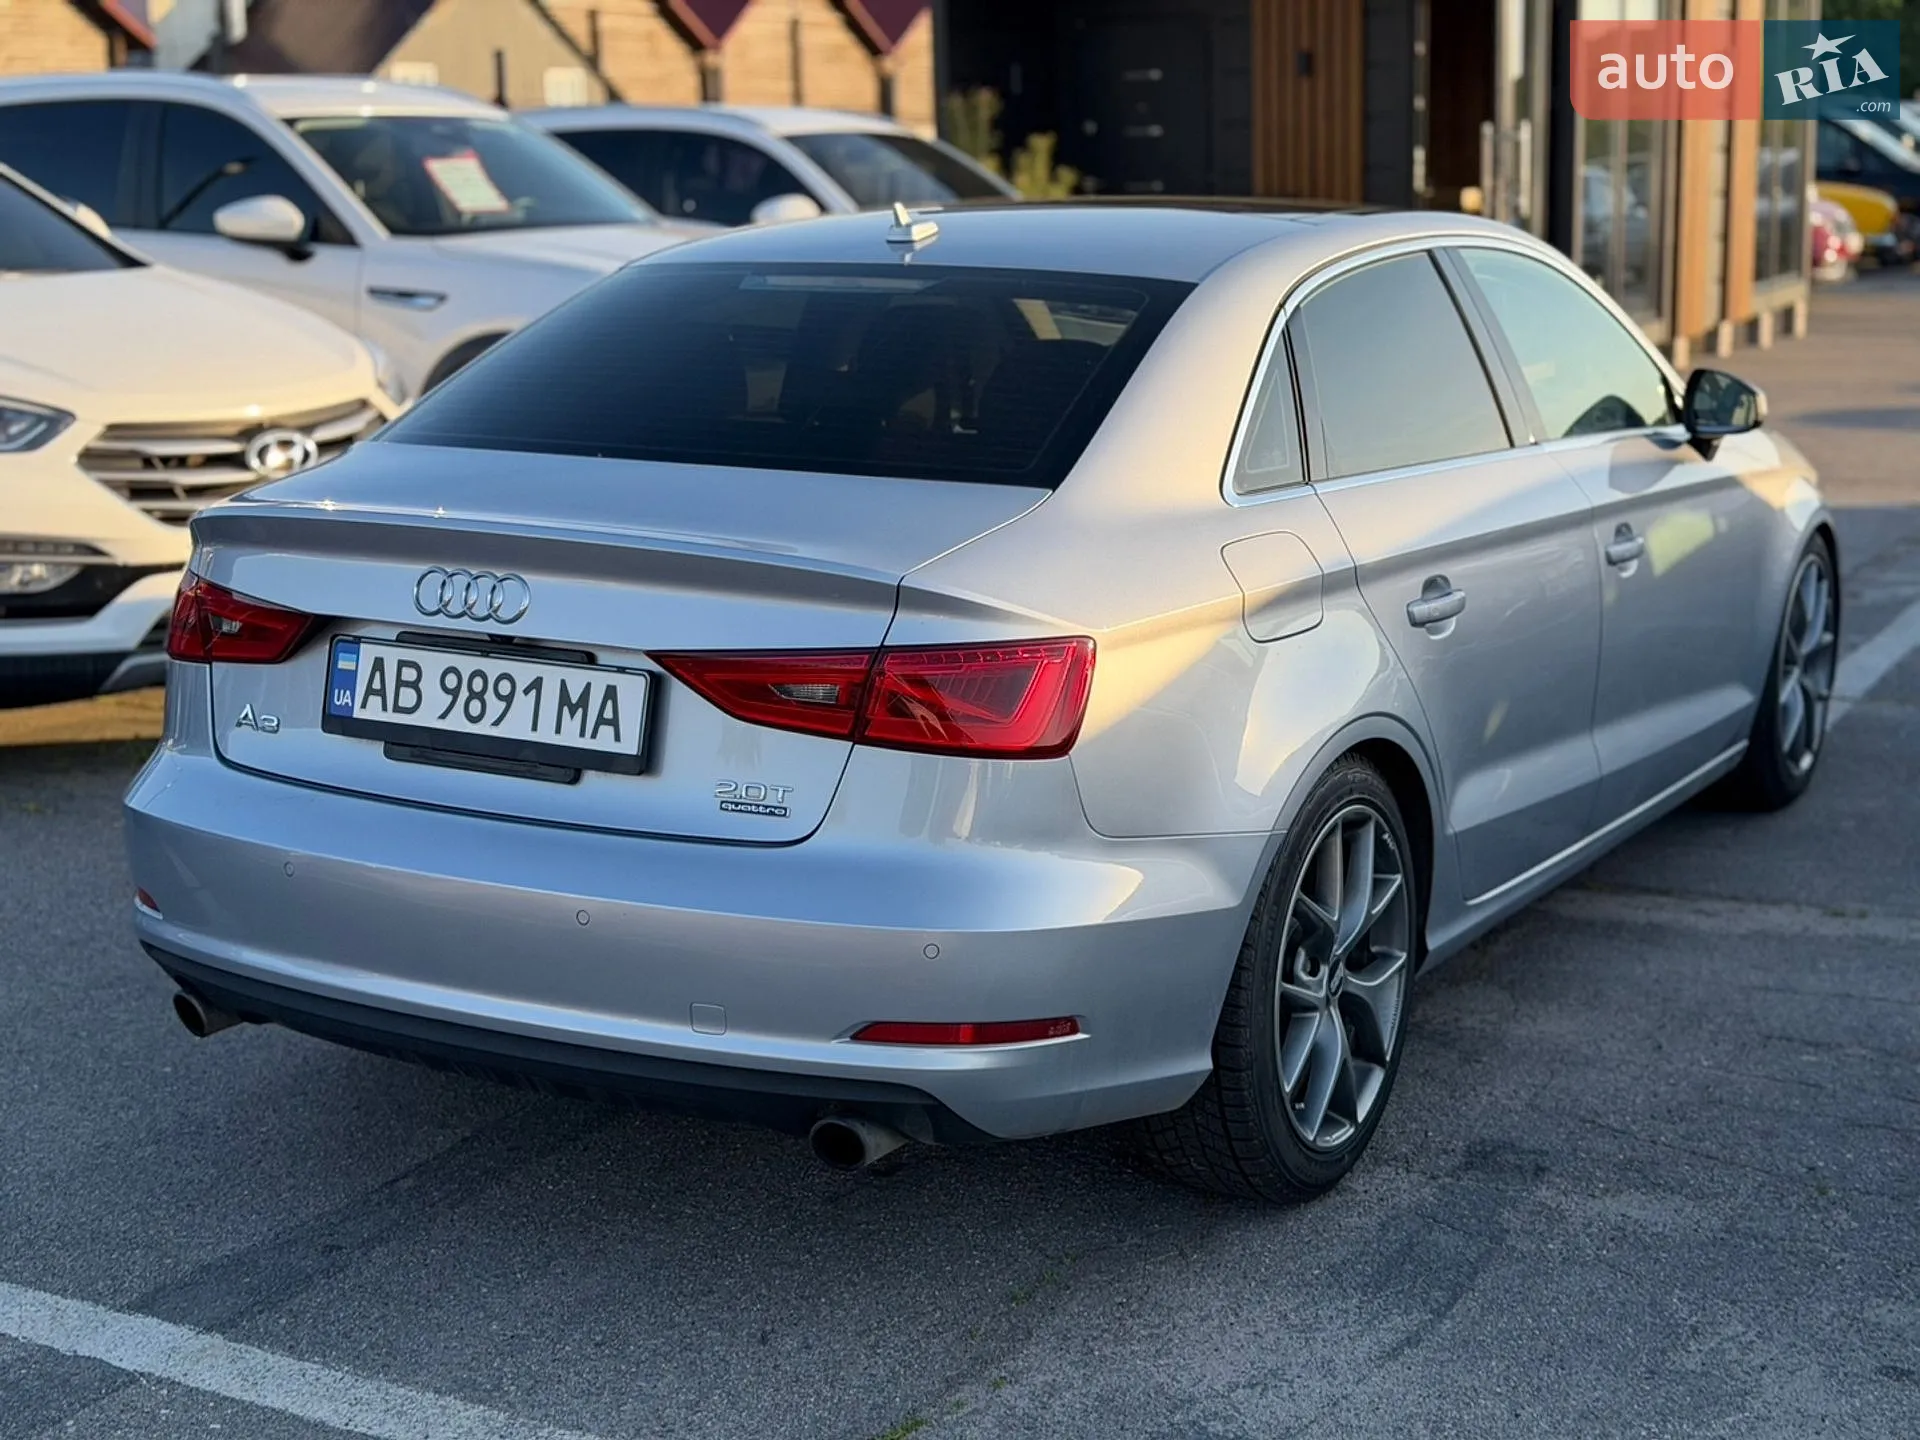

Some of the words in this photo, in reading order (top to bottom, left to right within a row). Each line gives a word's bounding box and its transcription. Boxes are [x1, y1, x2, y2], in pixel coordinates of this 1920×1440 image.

[334, 688, 352, 708] UA
[360, 656, 423, 715] AB
[438, 665, 544, 732] 9891
[554, 678, 622, 743] MA
[235, 703, 280, 734] A3
[721, 801, 786, 816] quattro
